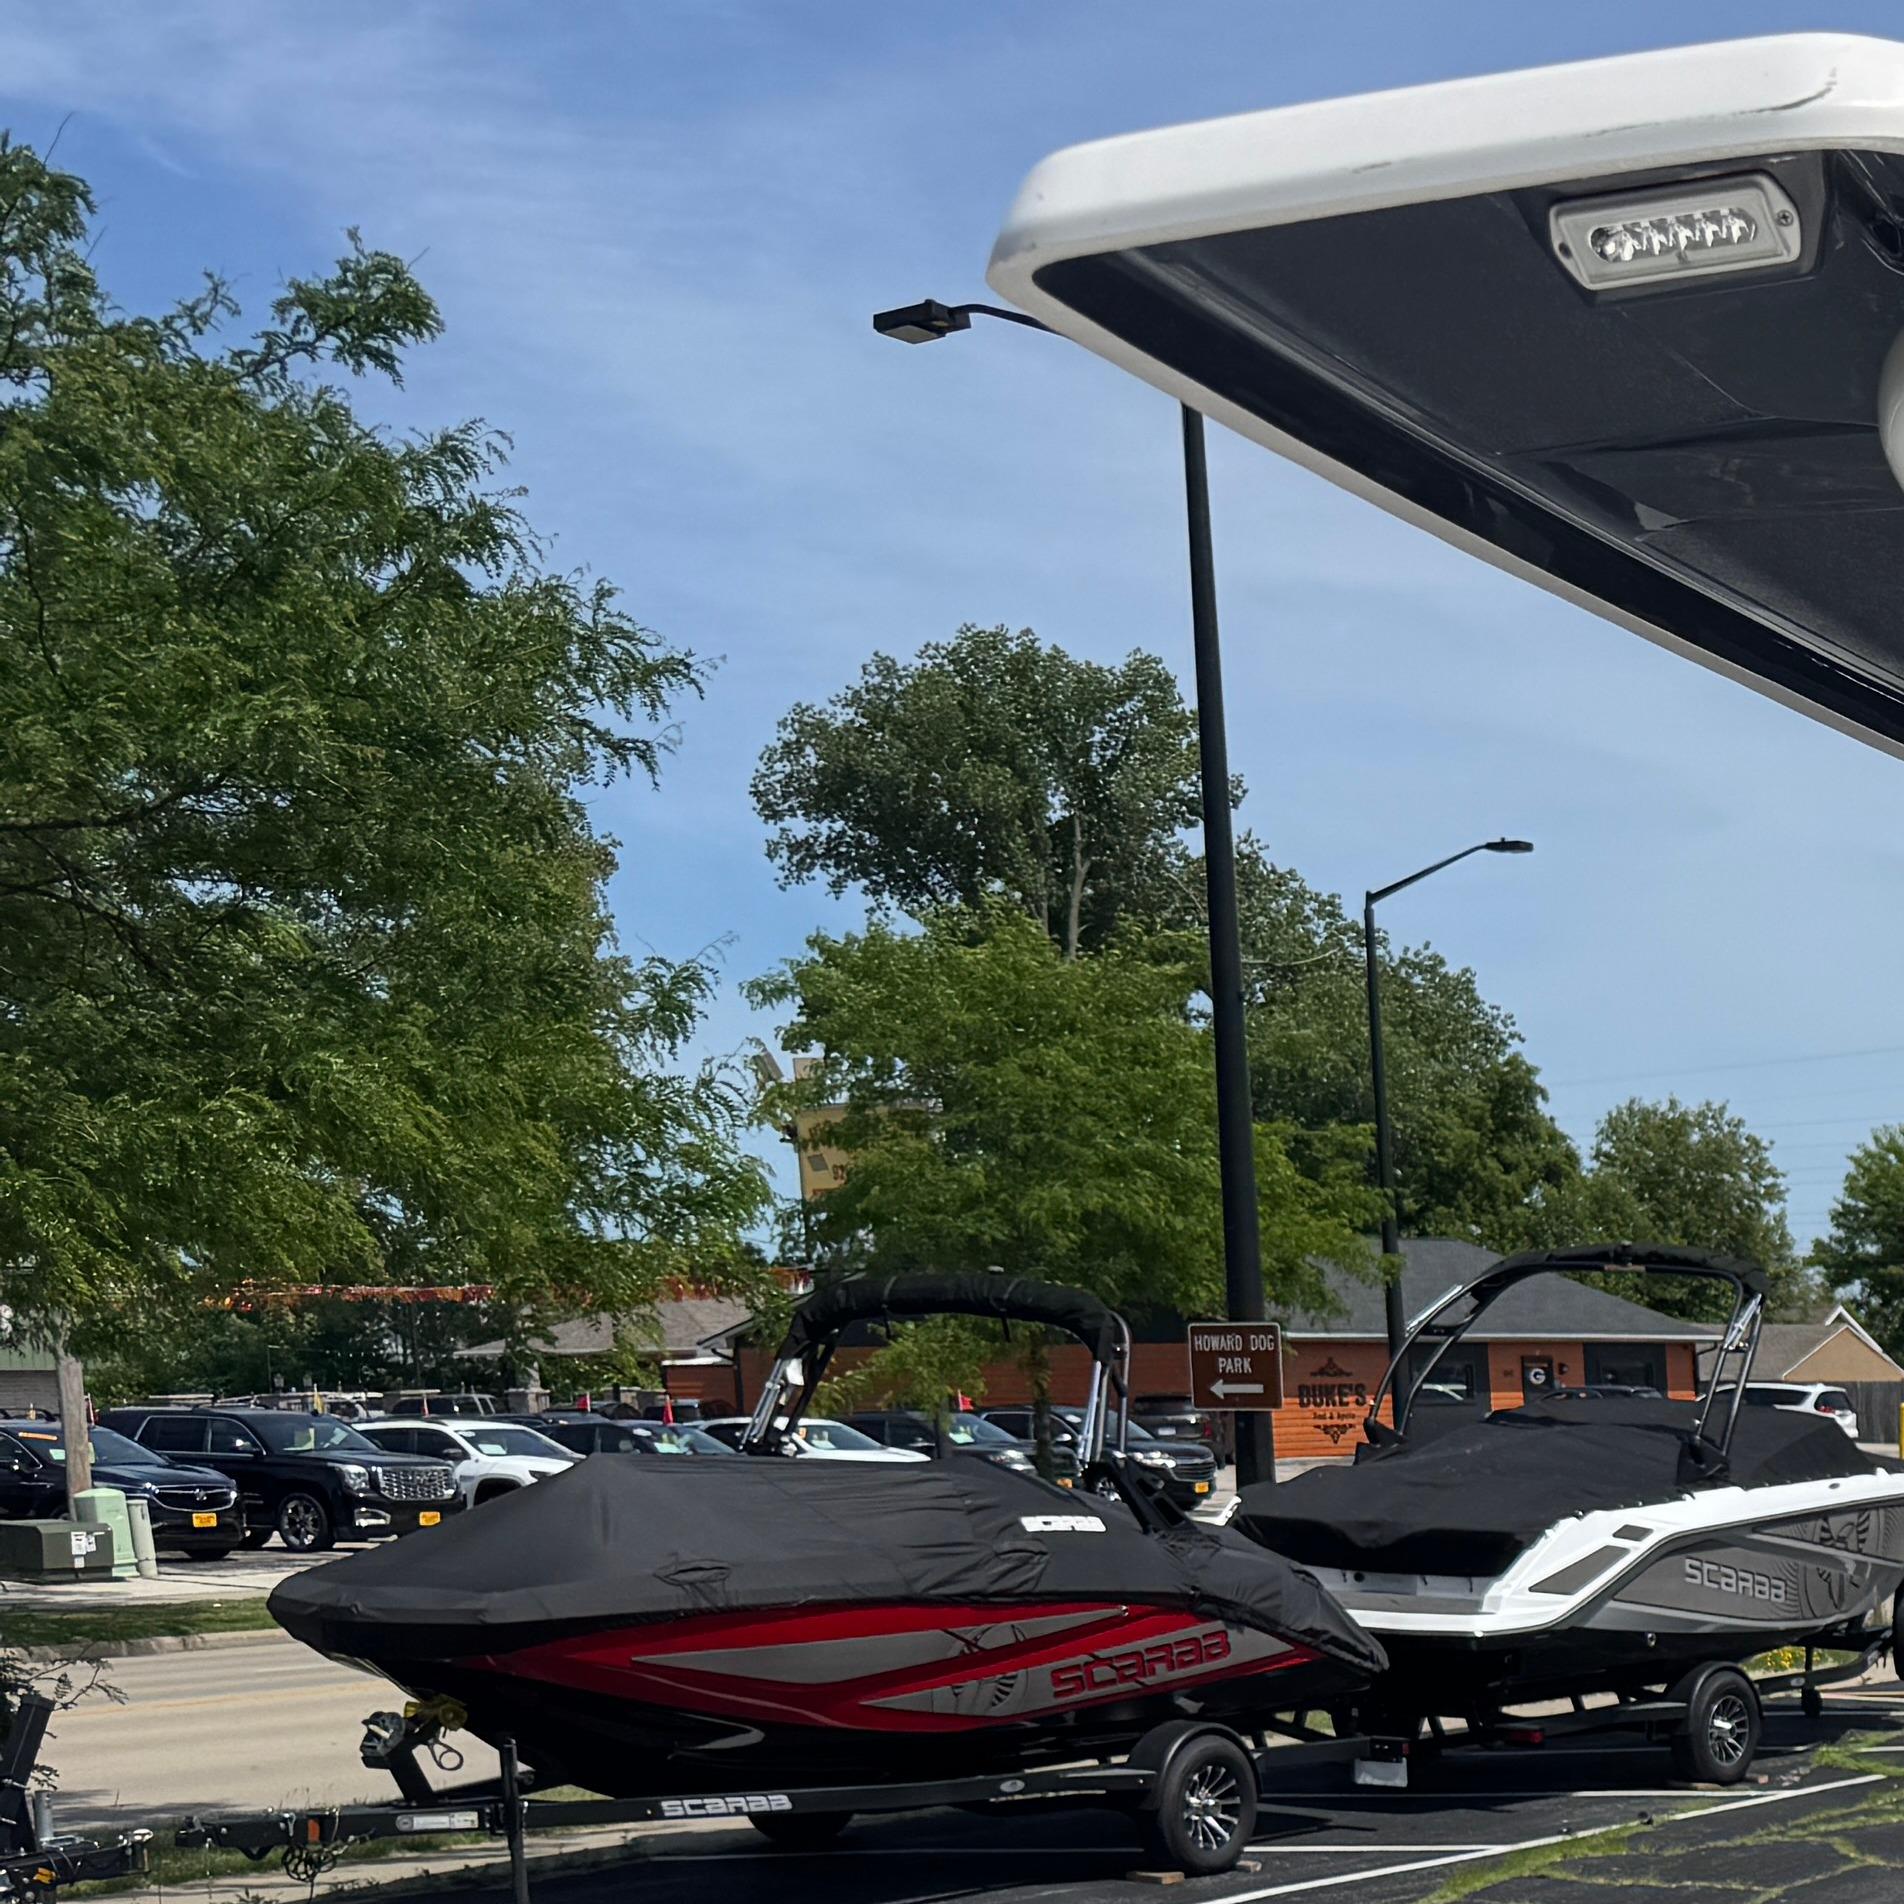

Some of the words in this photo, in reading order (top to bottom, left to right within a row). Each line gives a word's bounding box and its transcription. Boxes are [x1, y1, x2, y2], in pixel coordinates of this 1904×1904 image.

[1194, 1334, 1243, 1352] HOWARD
[1251, 1334, 1275, 1351] DOG
[1218, 1357, 1252, 1374] PARK
[1298, 1383, 1367, 1408] DUKE'S
